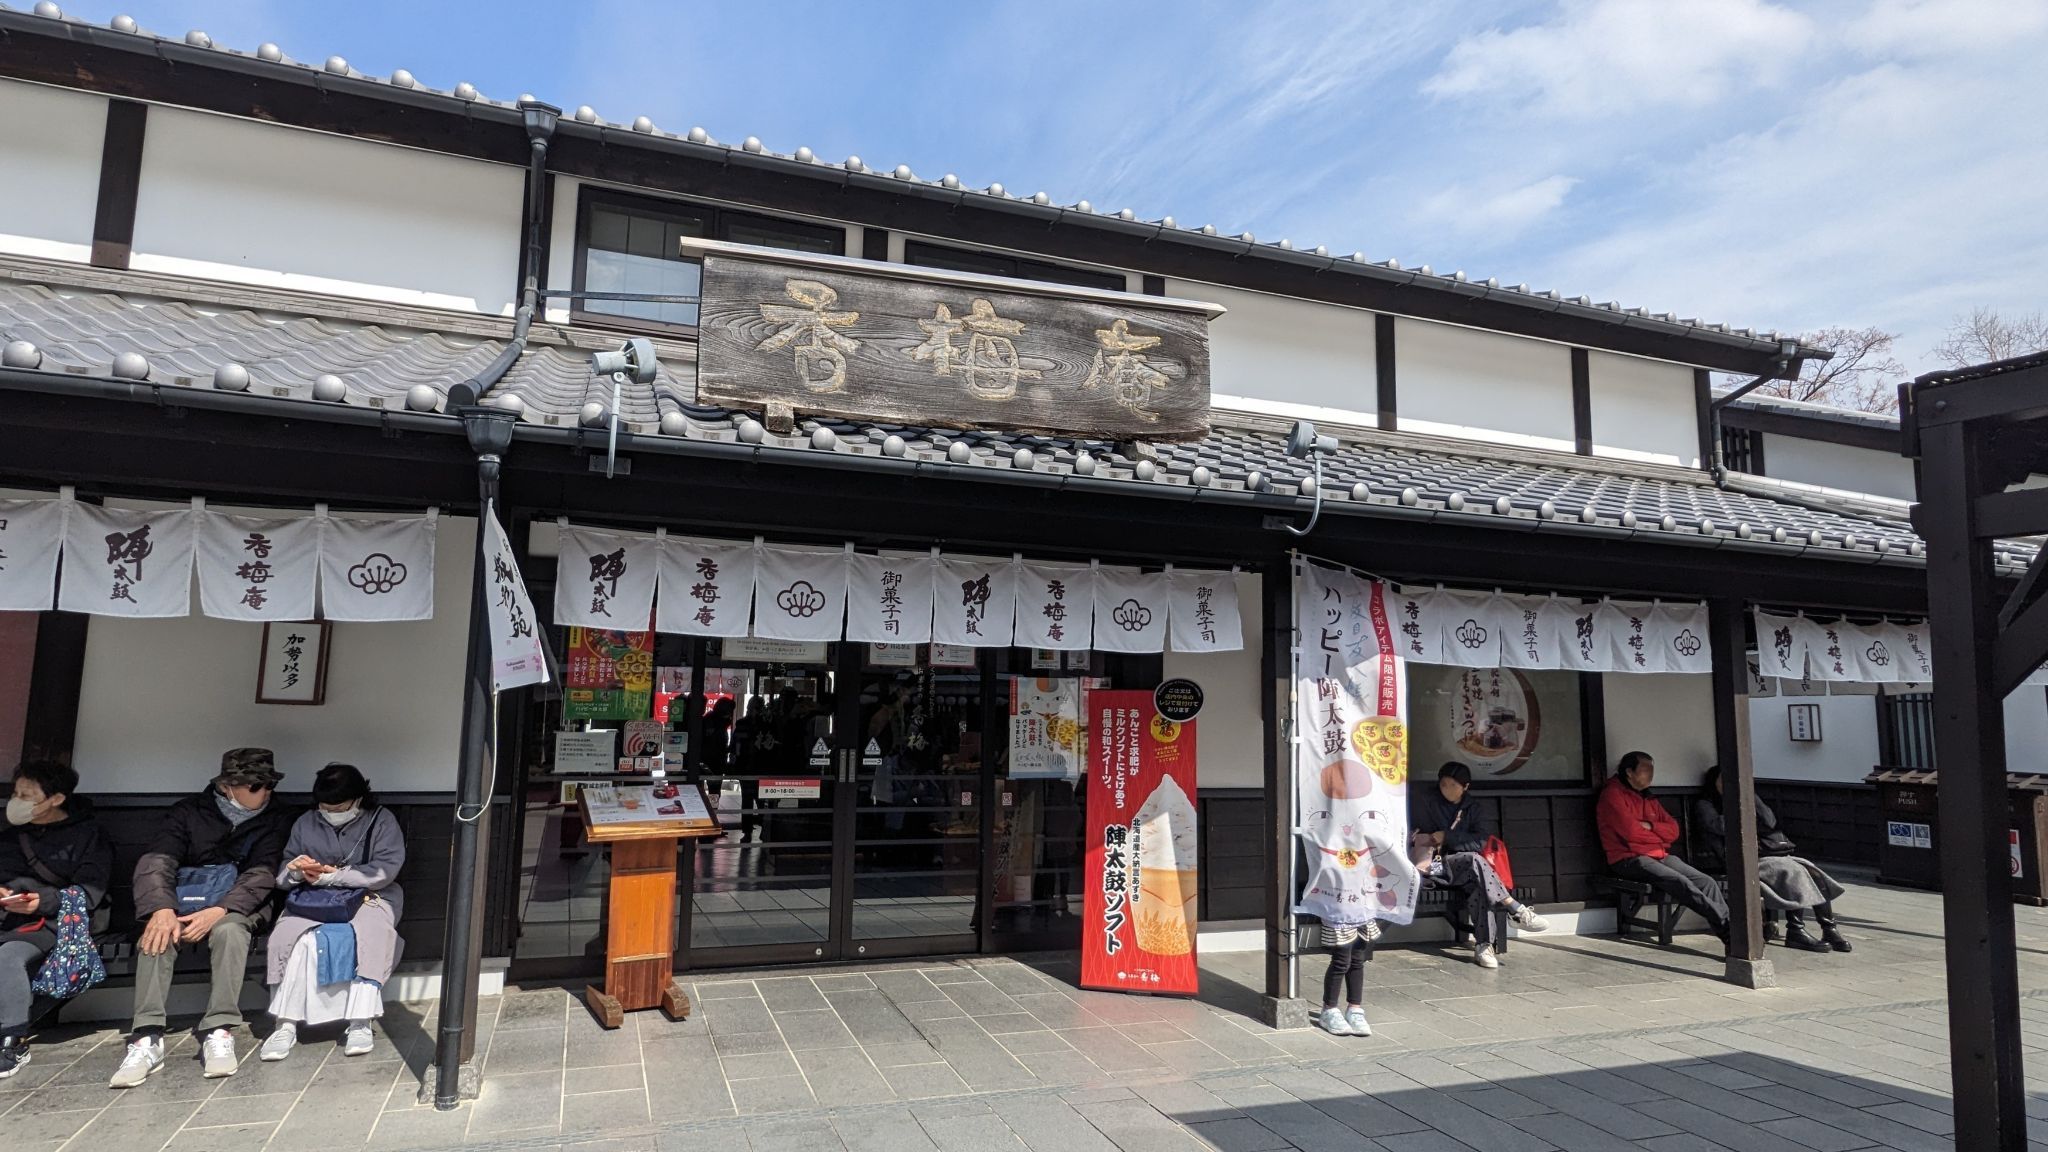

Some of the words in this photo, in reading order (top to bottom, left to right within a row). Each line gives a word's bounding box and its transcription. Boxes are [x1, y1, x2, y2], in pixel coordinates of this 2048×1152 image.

[105, 525, 154, 604] 陣太鼓
[236, 533, 275, 610] 香梅庵
[589, 547, 627, 618] 陣太鼓
[690, 558, 721, 627] 香梅庵
[880, 571, 903, 636] 御菓子司
[961, 573, 992, 637] 陣太鼓
[1043, 579, 1068, 642] 香梅庵
[1195, 586, 1216, 644] 御菓子司
[1402, 601, 1425, 655] 香梅庵
[1523, 609, 1541, 663] 御菓子司
[282, 633, 306, 690] 加勢以多
[1316, 586, 1347, 755] ハッピー陣太鼓
[1371, 594, 1394, 711] コラボアイテム限定販売
[1575, 613, 1595, 664] 陣太鼓
[1628, 616, 1647, 667] 香梅庵
[1827, 629, 1845, 675] 香梅庵
[1101, 708, 1113, 790] 自慢の和スイーツ。
[1115, 708, 1126, 809] ミルクソフトにとけあう
[1129, 708, 1140, 777] あんこと求肥が
[1104, 824, 1128, 955] 陣太鼓ソフト
[1131, 817, 1141, 903] 北海道産大納言あずき
